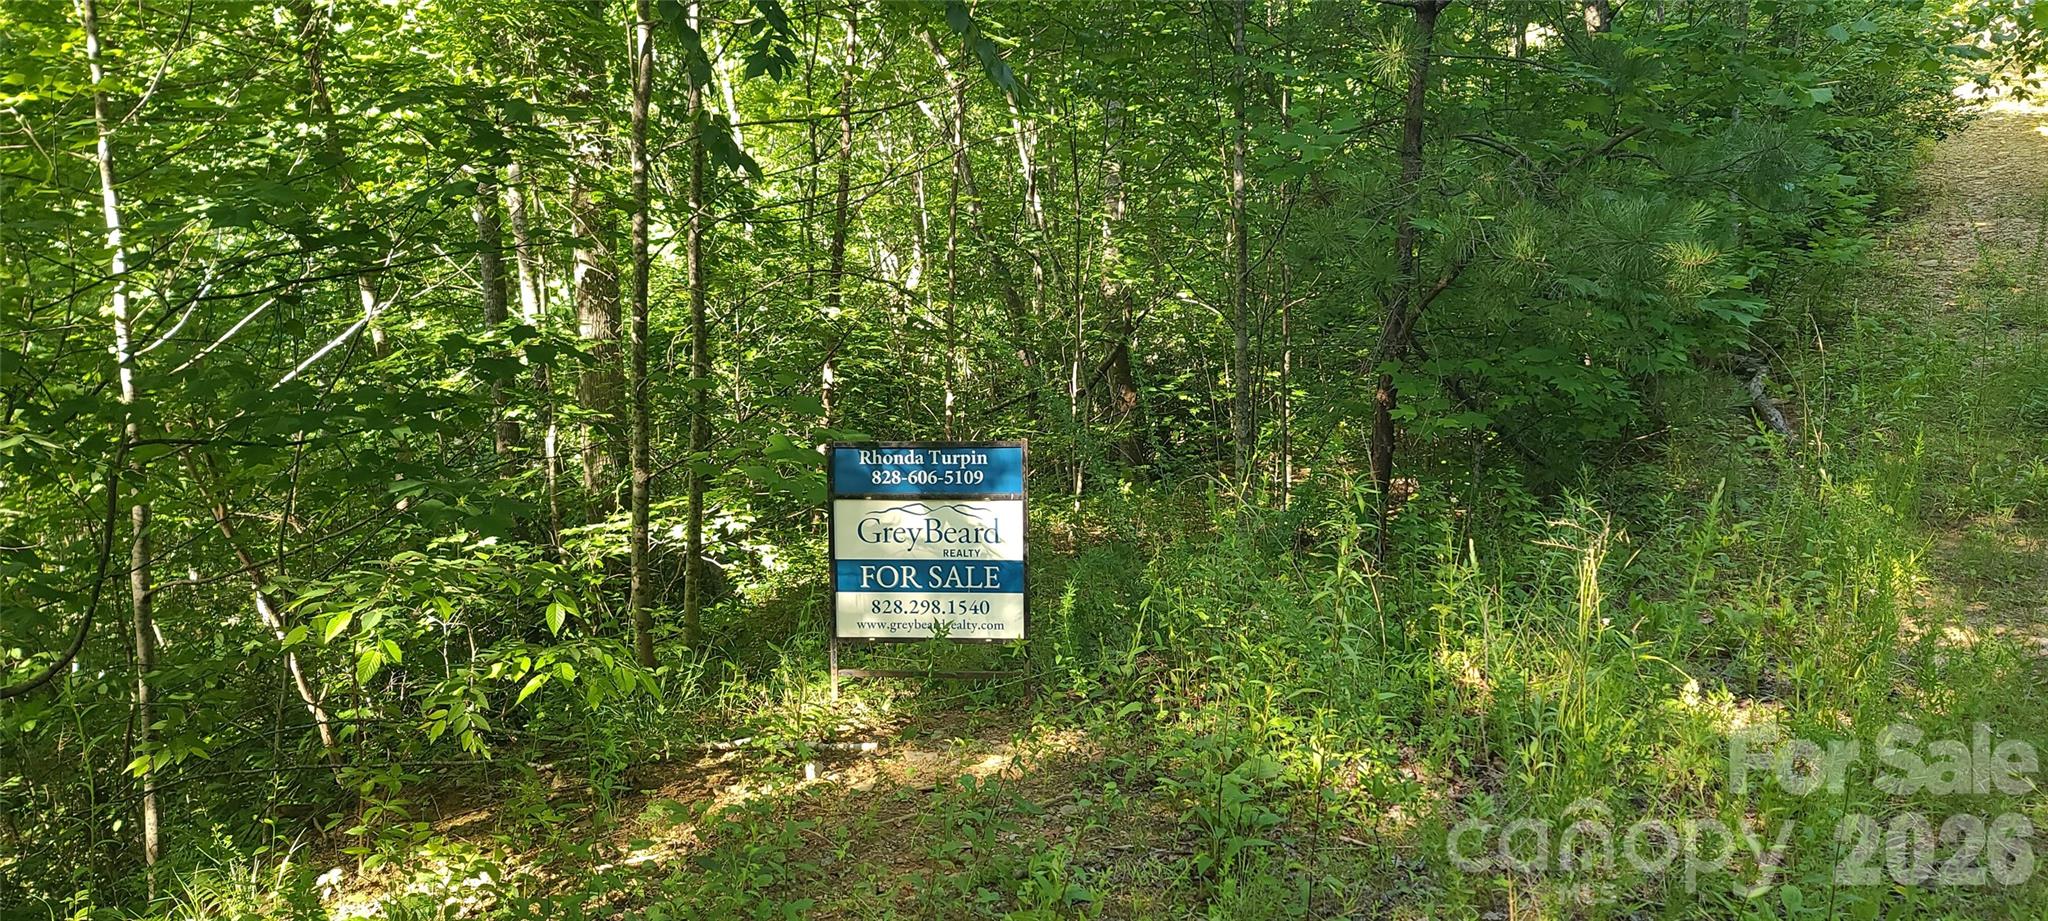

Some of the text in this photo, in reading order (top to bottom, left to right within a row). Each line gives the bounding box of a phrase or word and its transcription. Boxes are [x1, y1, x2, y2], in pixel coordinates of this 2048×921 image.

[859, 450, 988, 468] Rhonda Turpin
[871, 470, 984, 485] 828-606-5109
[857, 517, 1001, 551] GreyBeard
[943, 549, 981, 558] REALTY
[860, 565, 1001, 590] FOR SALE
[871, 599, 990, 615] 828.298.1540
[856, 618, 1005, 633] www.greybeadealty.com
